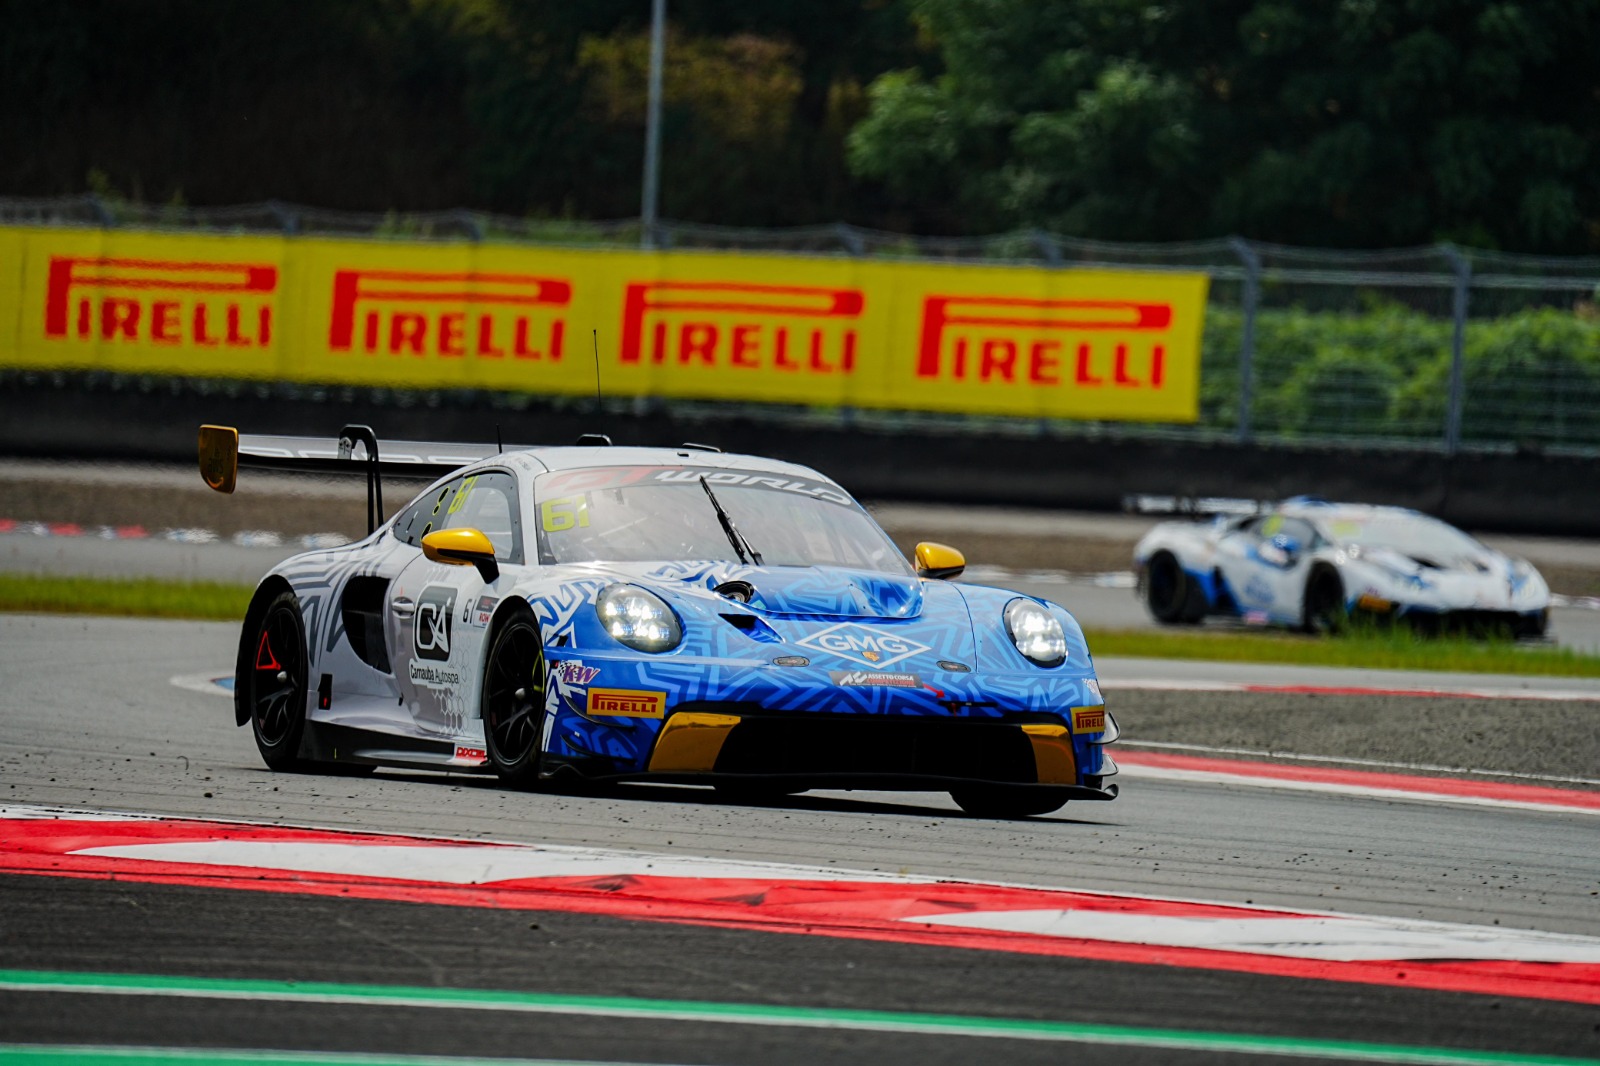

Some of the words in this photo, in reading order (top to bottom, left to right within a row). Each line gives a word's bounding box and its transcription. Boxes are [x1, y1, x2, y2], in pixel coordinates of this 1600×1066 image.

[45, 256, 278, 347] PIRELLI
[329, 269, 573, 361] PIRELLI
[619, 281, 865, 373] PIRELLI
[916, 294, 1172, 388] PIRELLI
[655, 470, 851, 505] WORLD
[541, 495, 590, 533] 61
[463, 598, 477, 624] 61
[818, 634, 909, 653] GMG
[563, 665, 600, 683] KW
[592, 693, 659, 714] PIRELLI
